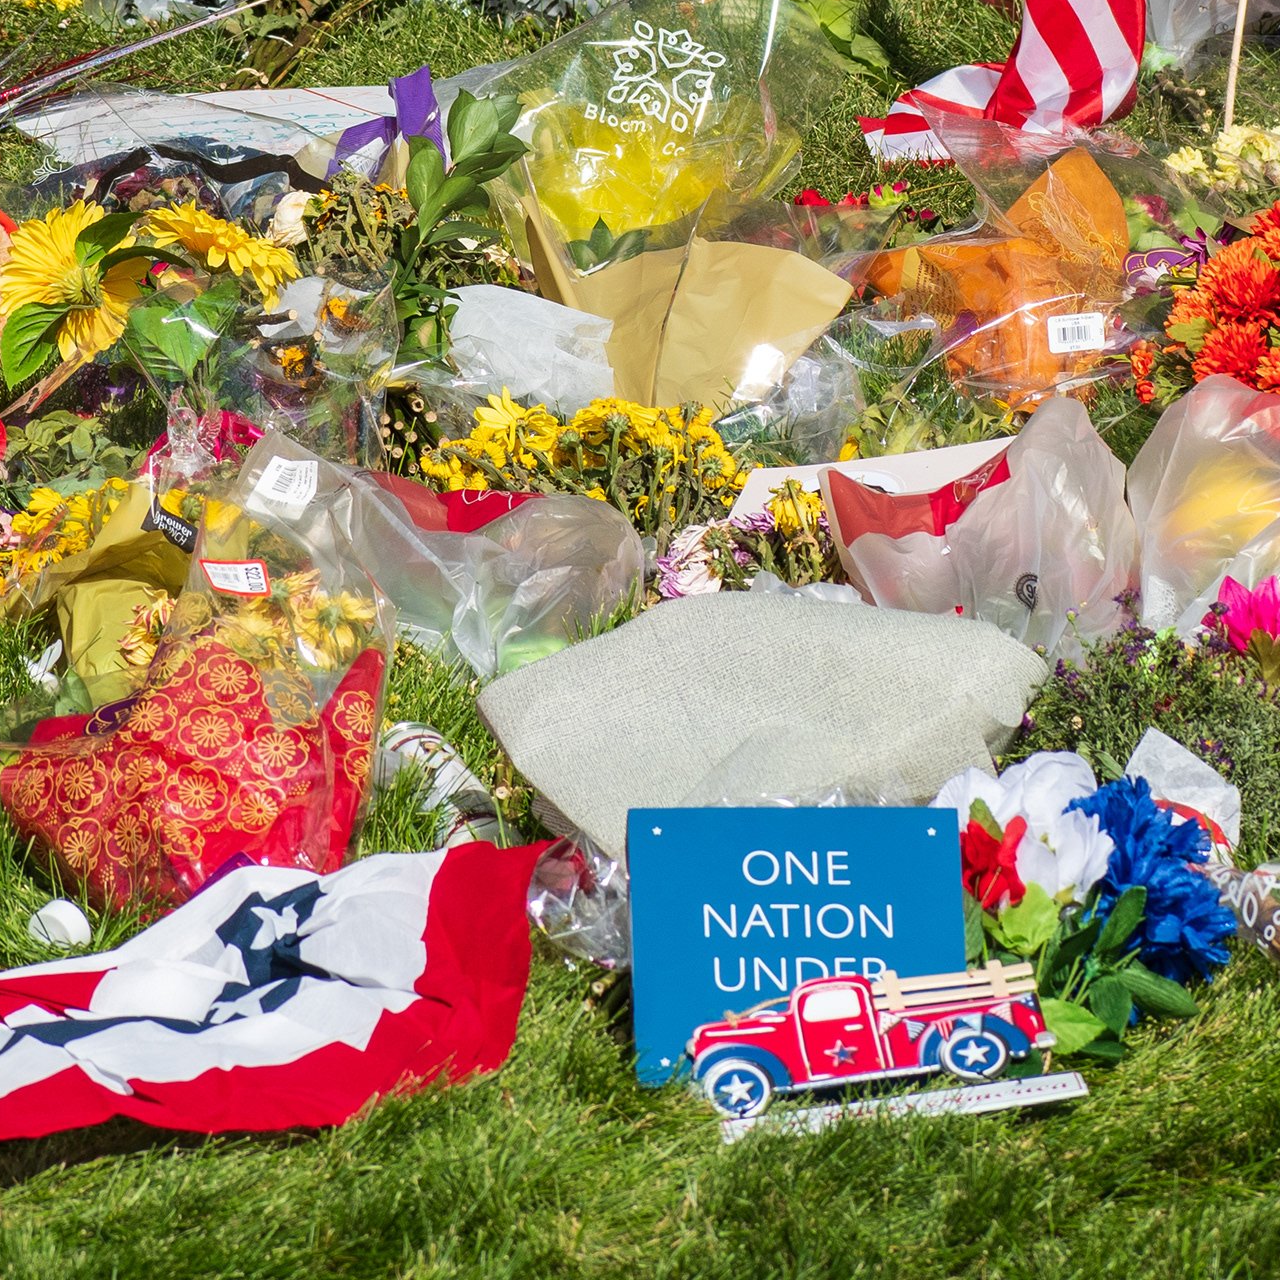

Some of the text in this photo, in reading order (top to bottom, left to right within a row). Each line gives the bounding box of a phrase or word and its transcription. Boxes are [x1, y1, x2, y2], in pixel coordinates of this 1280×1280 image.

[153, 511, 193, 539] grower
[244, 567, 265, 592] $22.00
[742, 850, 851, 886] ONE
[703, 903, 894, 939] NATION
[714, 957, 887, 992] UNDER
